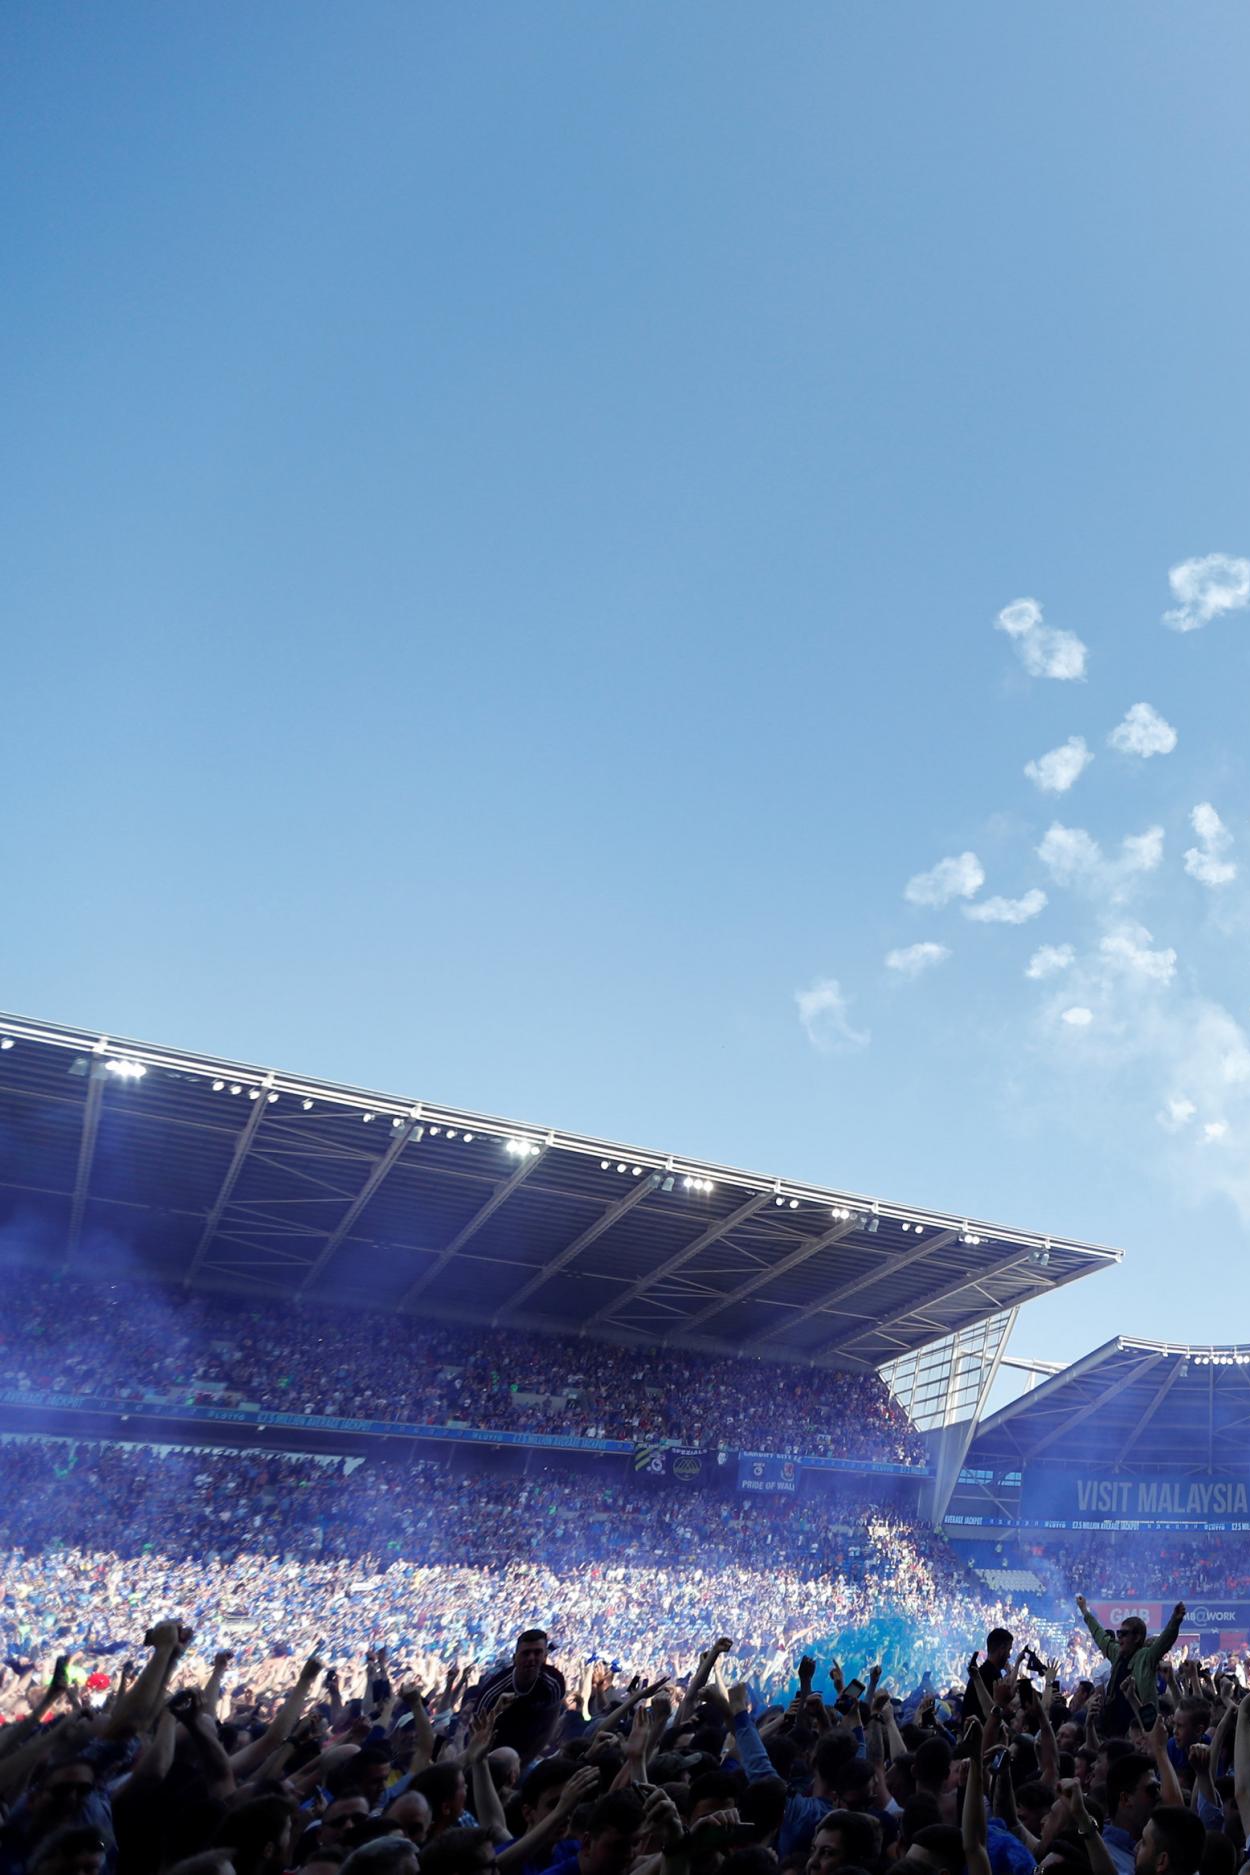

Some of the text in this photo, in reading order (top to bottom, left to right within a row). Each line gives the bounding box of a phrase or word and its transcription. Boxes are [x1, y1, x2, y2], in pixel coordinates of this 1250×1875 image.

[742, 1480, 764, 1490] PRIDE
[765, 1481, 776, 1490] OF
[1077, 1479, 1249, 1514] VISIT MALAYSIA
[944, 1515, 963, 1525] AVERAGE
[963, 1516, 983, 1526] JACKPOT
[1082, 1521, 1100, 1530] MILLION
[1100, 1521, 1120, 1531] AVERAGE
[1120, 1521, 1139, 1531] JACKPOT
[1110, 1608, 1150, 1625] GMB
[1183, 1606, 1236, 1627] MB@WORK
